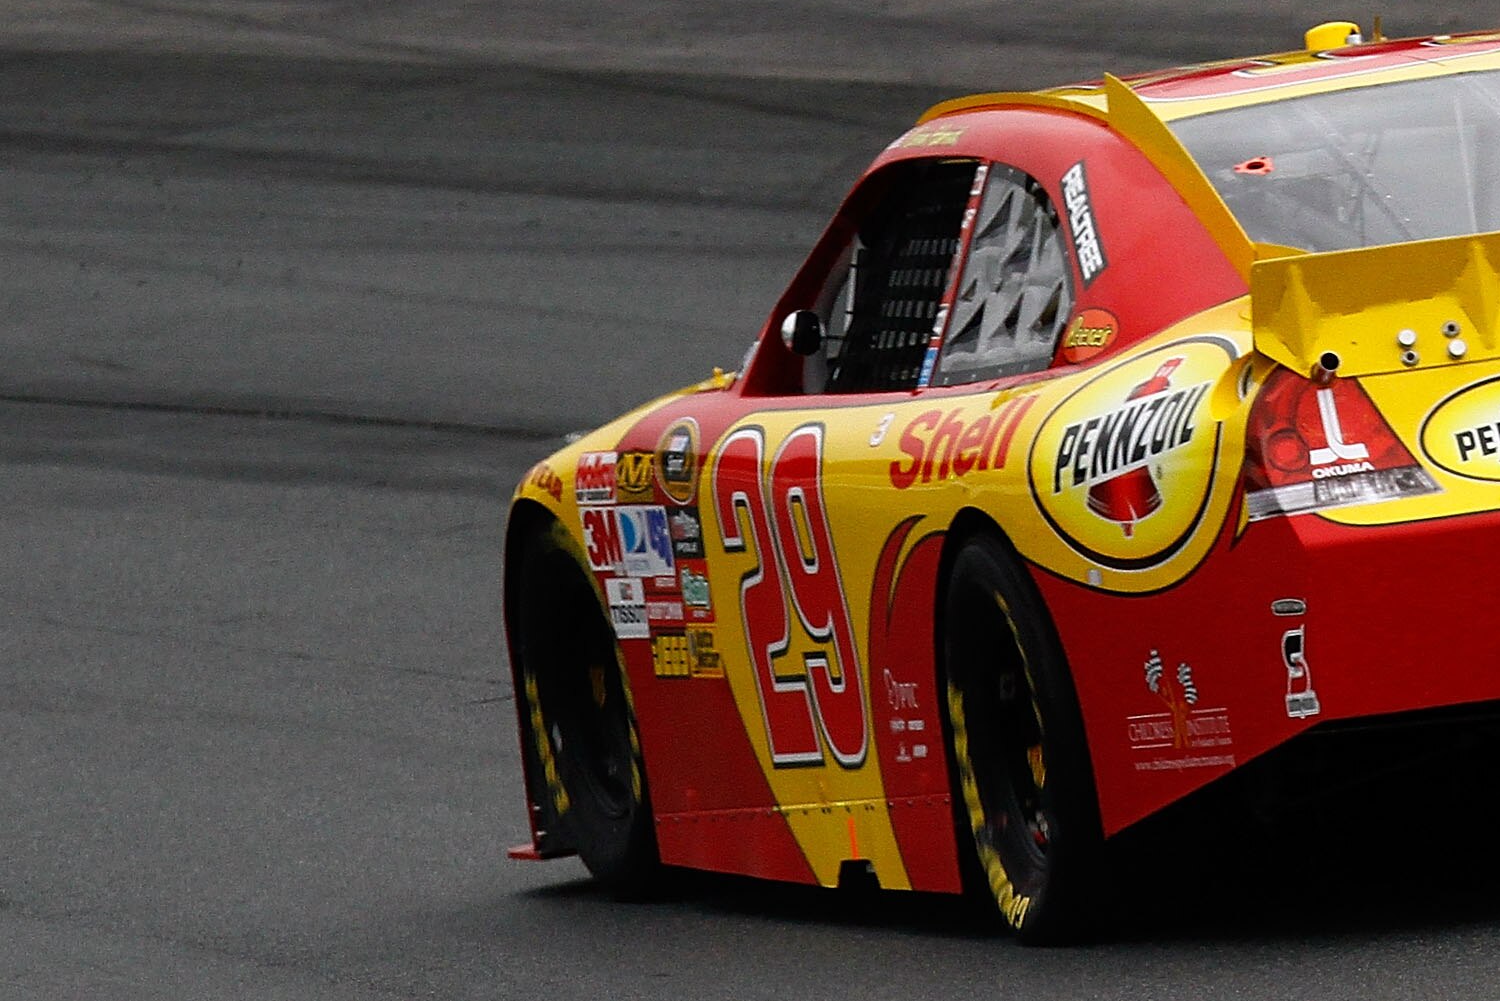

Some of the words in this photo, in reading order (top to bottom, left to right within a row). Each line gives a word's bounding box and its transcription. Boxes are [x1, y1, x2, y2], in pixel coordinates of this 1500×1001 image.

[1060, 163, 1104, 280] REALTREE
[889, 395, 1040, 490] Shell
[1052, 380, 1214, 495] PENNZOIL
[1312, 461, 1375, 479] OKUMA
[583, 508, 624, 567] 3M
[711, 421, 869, 769] 29
